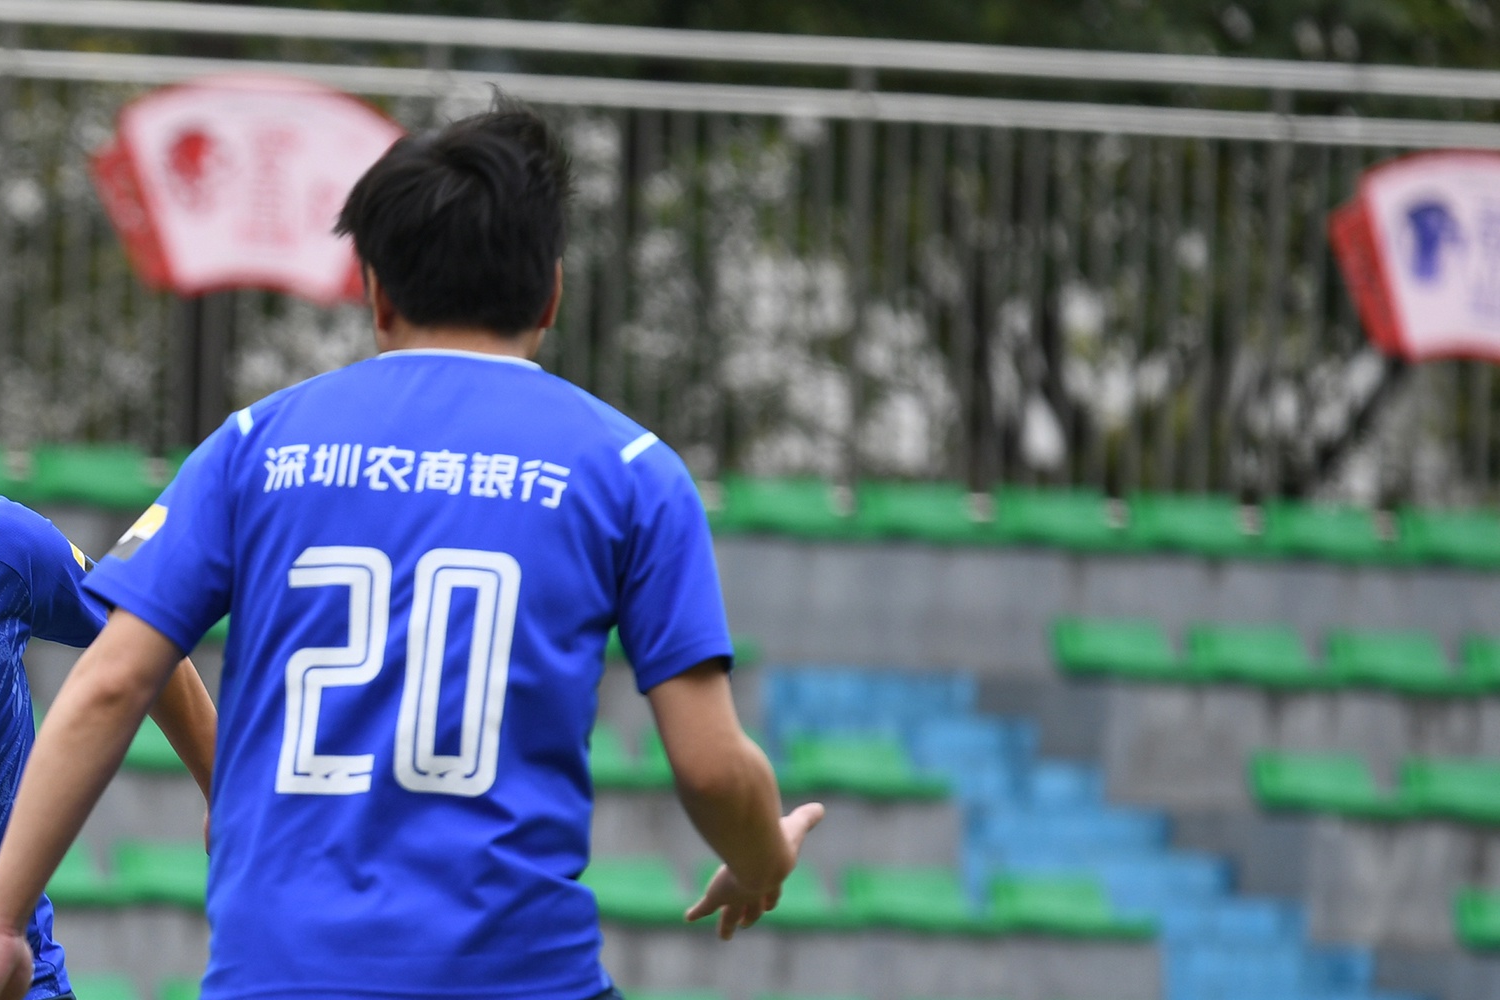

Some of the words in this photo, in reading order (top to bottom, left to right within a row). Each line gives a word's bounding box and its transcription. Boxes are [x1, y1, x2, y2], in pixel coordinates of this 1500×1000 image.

[263, 444, 571, 509] 深圳农商银行
[276, 546, 521, 797] 20
